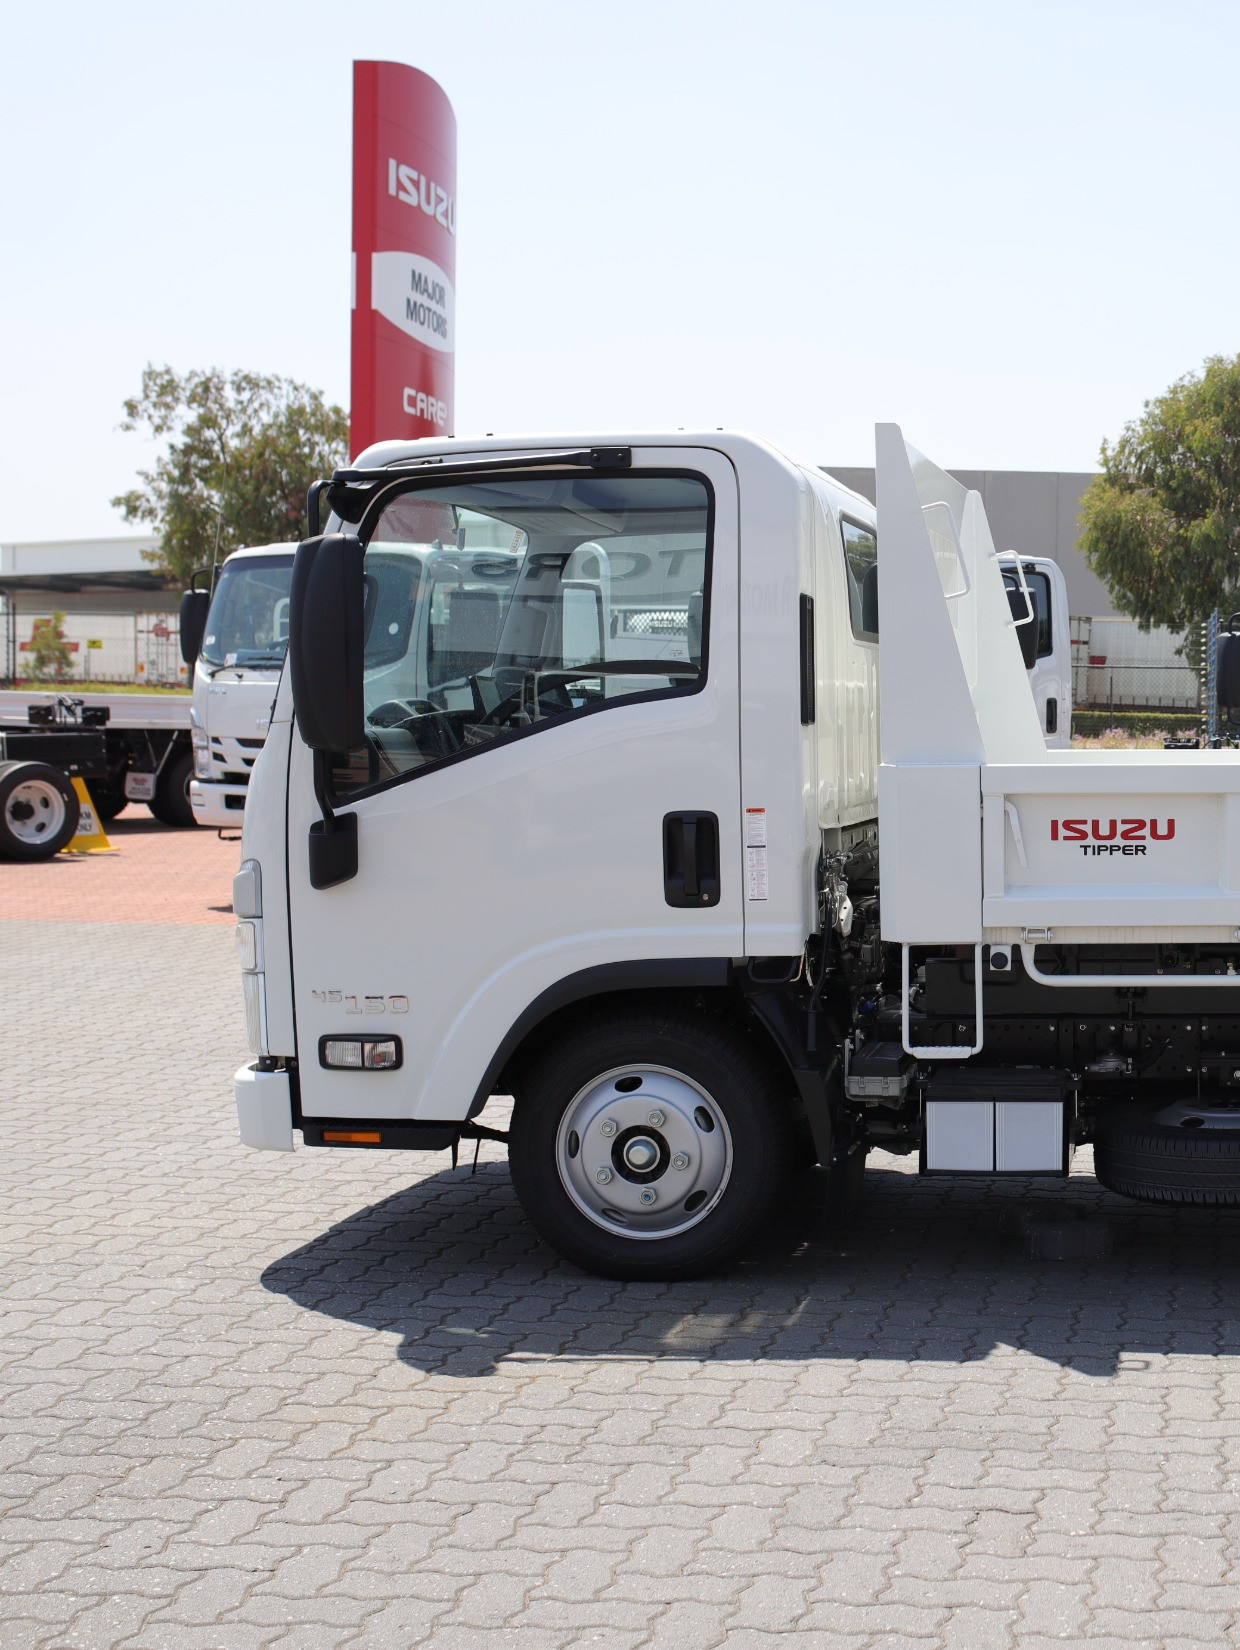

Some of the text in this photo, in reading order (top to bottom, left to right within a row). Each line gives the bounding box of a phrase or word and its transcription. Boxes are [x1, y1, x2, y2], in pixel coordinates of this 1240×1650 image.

[388, 157, 456, 236] ISUZU
[411, 268, 446, 310] MAJOR
[406, 296, 447, 340] MOTORS
[403, 386, 447, 427] CARE
[1050, 818, 1176, 841] ISUZU
[1079, 844, 1147, 856] TIPPER
[311, 989, 409, 1015] 45 150
